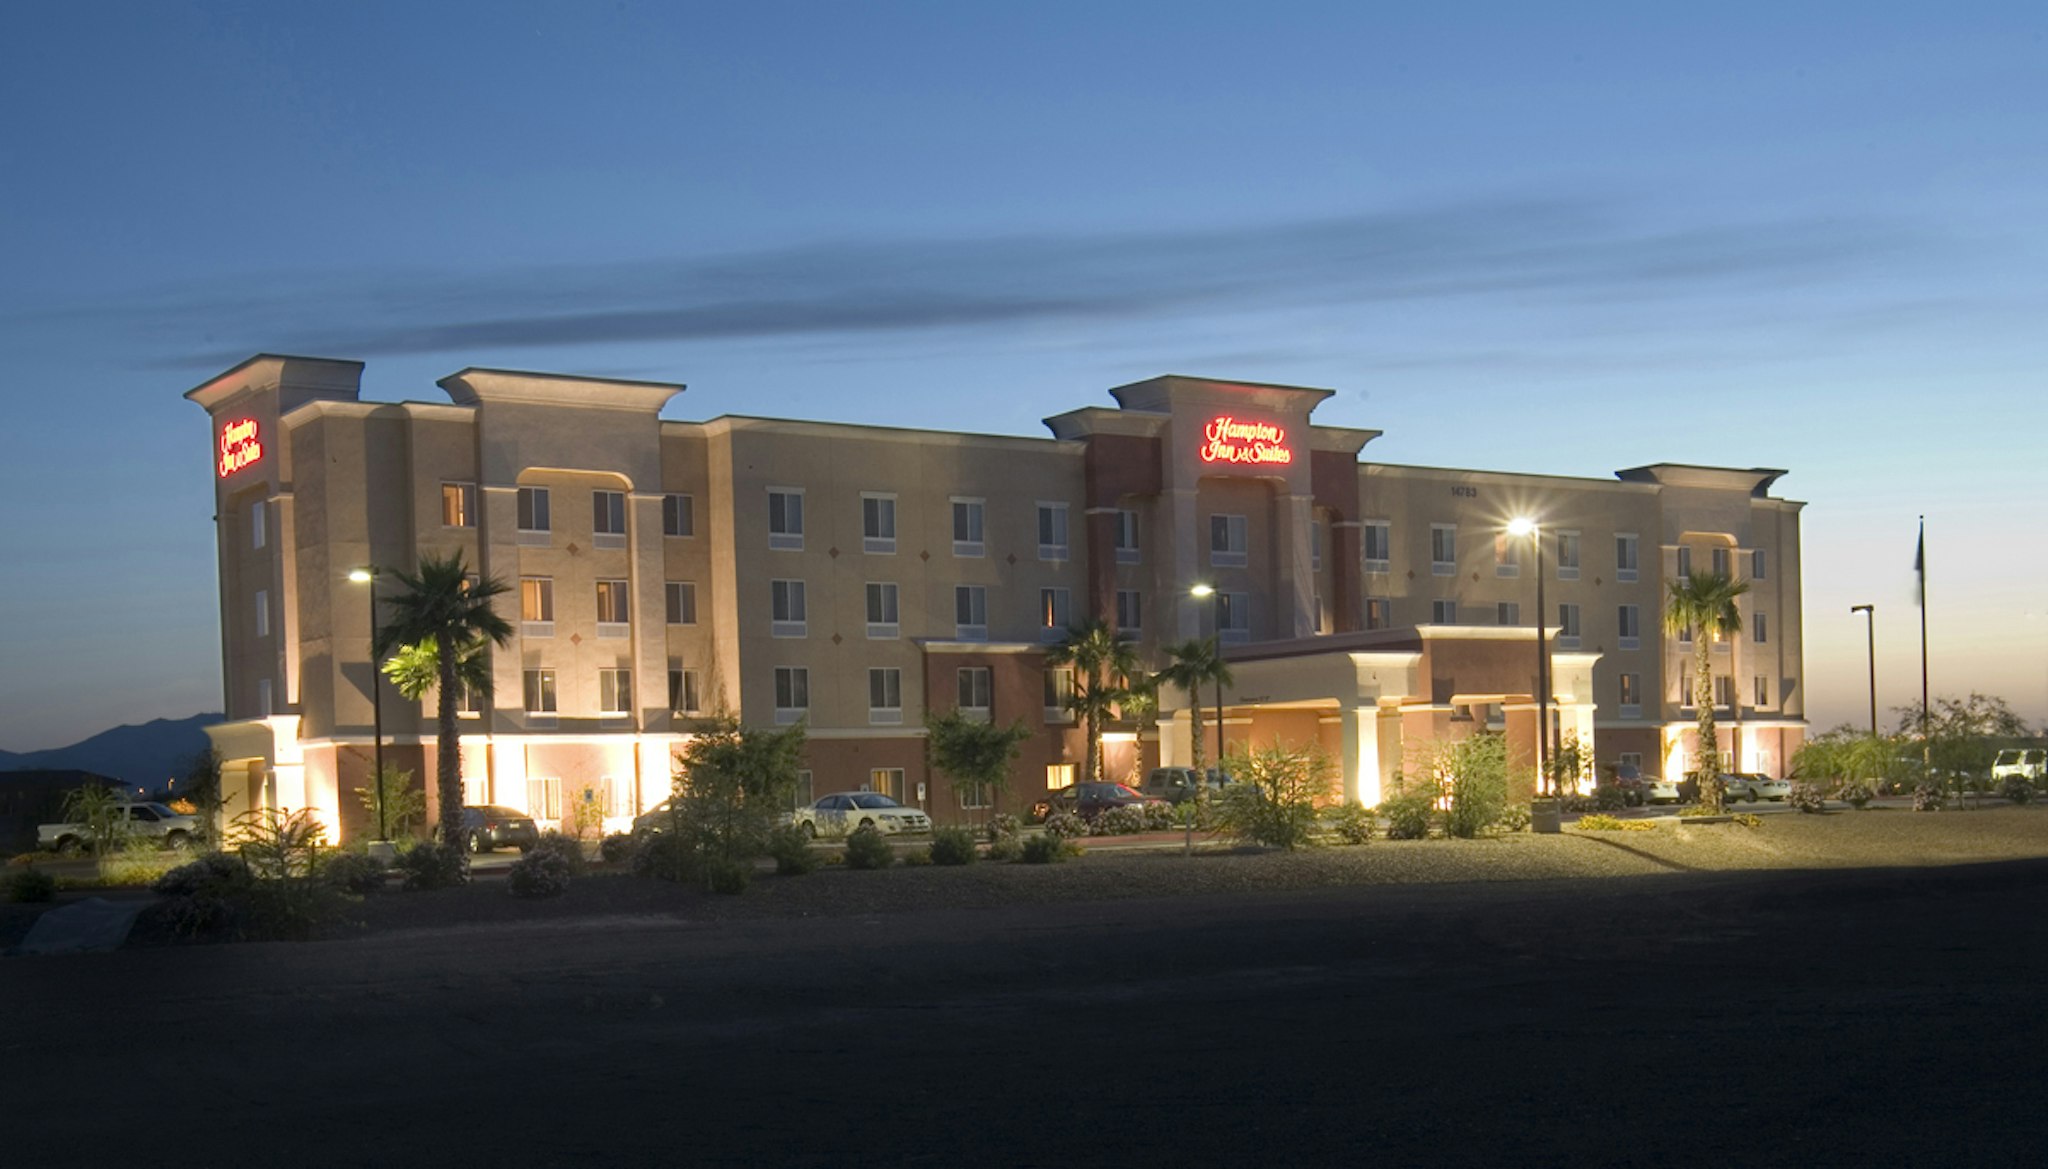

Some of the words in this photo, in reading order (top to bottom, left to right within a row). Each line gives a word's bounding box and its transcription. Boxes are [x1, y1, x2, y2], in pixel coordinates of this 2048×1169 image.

[1205, 417, 1284, 444] Hampton
[1201, 440, 1240, 462] Inn
[1249, 441, 1291, 463] Suites
